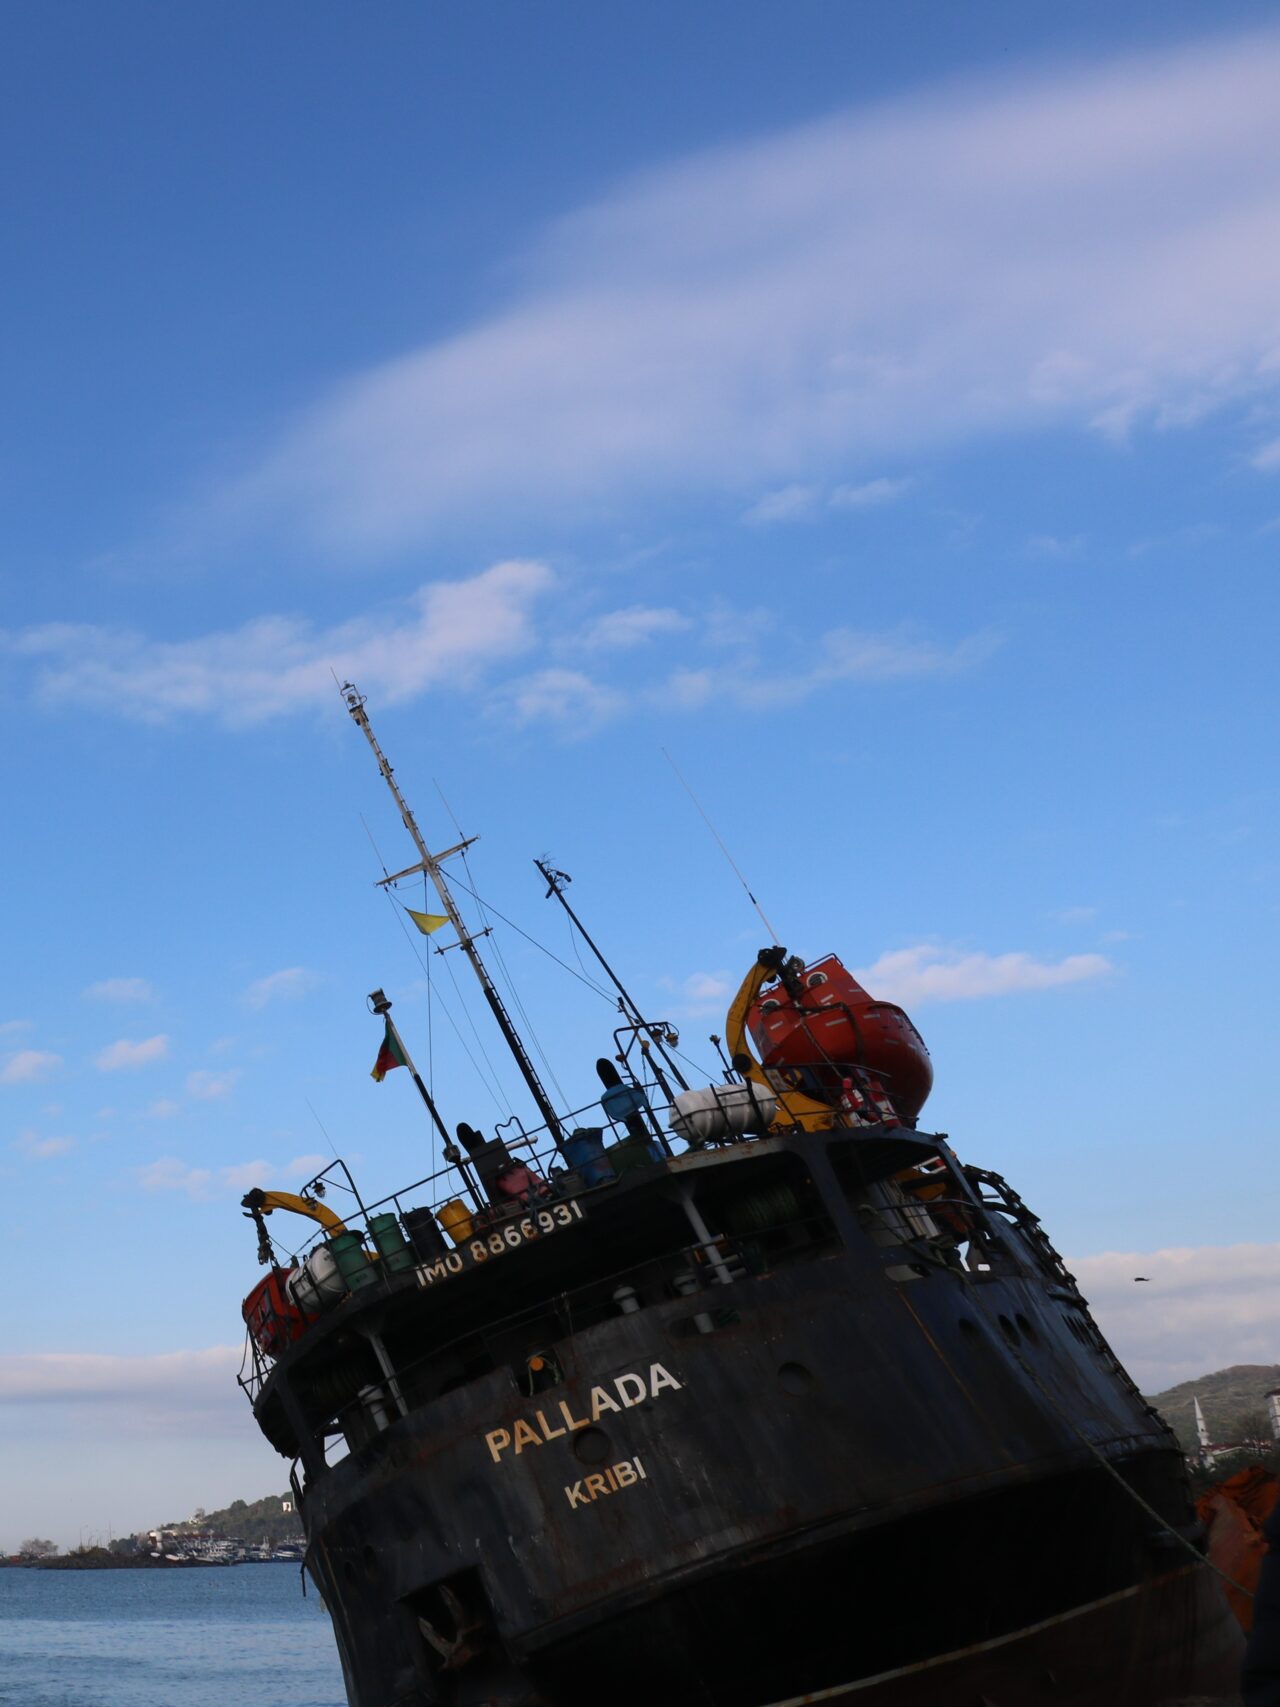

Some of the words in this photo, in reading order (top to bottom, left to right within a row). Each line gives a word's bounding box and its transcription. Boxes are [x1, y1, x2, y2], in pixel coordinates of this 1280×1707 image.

[415, 1252, 464, 1287] IMO
[470, 1200, 584, 1264] 8866931
[484, 1362, 683, 1463] PALLADA
[564, 1456, 647, 1509] KRIBI
